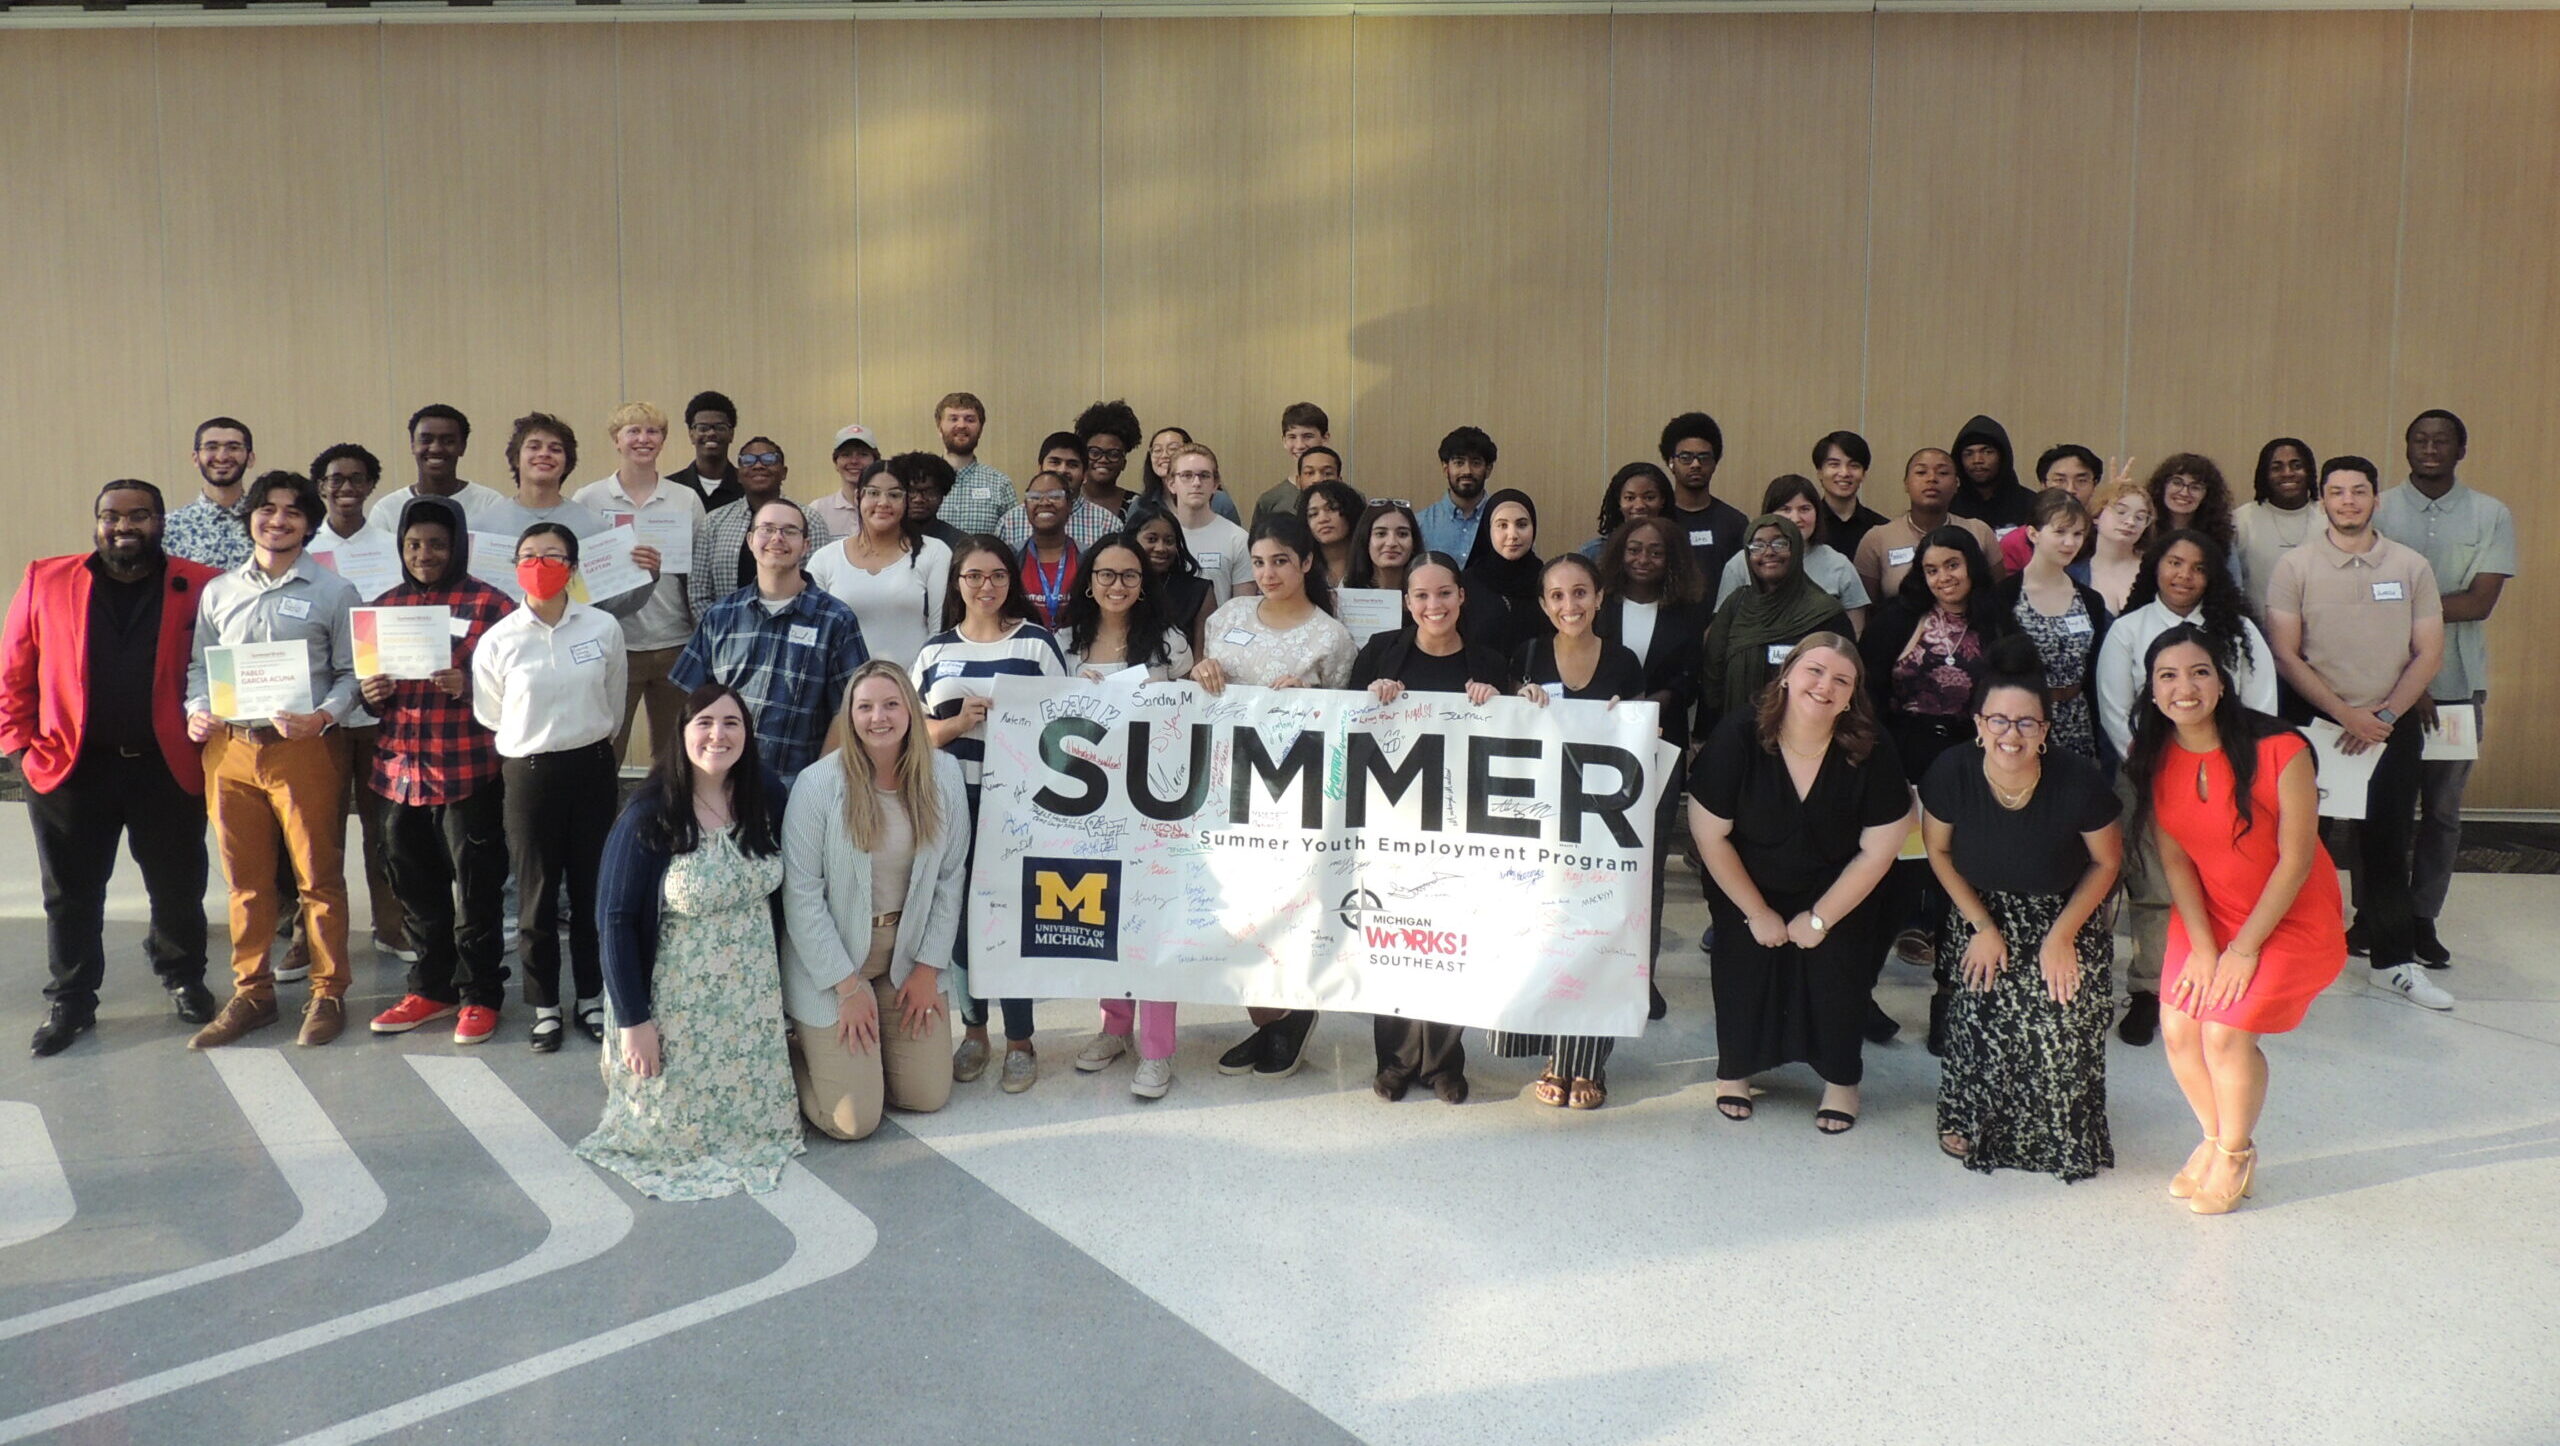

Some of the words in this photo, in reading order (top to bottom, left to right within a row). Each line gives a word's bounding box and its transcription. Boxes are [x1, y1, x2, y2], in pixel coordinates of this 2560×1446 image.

[240, 669, 265, 677] PABLO
[241, 677, 268, 685] GARCIA
[1032, 716, 1644, 849] SUMMER
[1200, 830, 1290, 850] Summer
[1301, 835, 1366, 853] Youth
[1379, 838, 1526, 861] Employment
[1538, 848, 1638, 872] Program
[1035, 870, 1108, 926] M
[1373, 915, 1432, 927] MICHIGAN
[1035, 924, 1091, 936] UNIVERSITY
[1092, 930, 1105, 938] OF
[1035, 933, 1105, 949] MICHIGAN
[1365, 926, 1467, 956] WORKS!
[1370, 954, 1467, 973] SOUTHEAST
